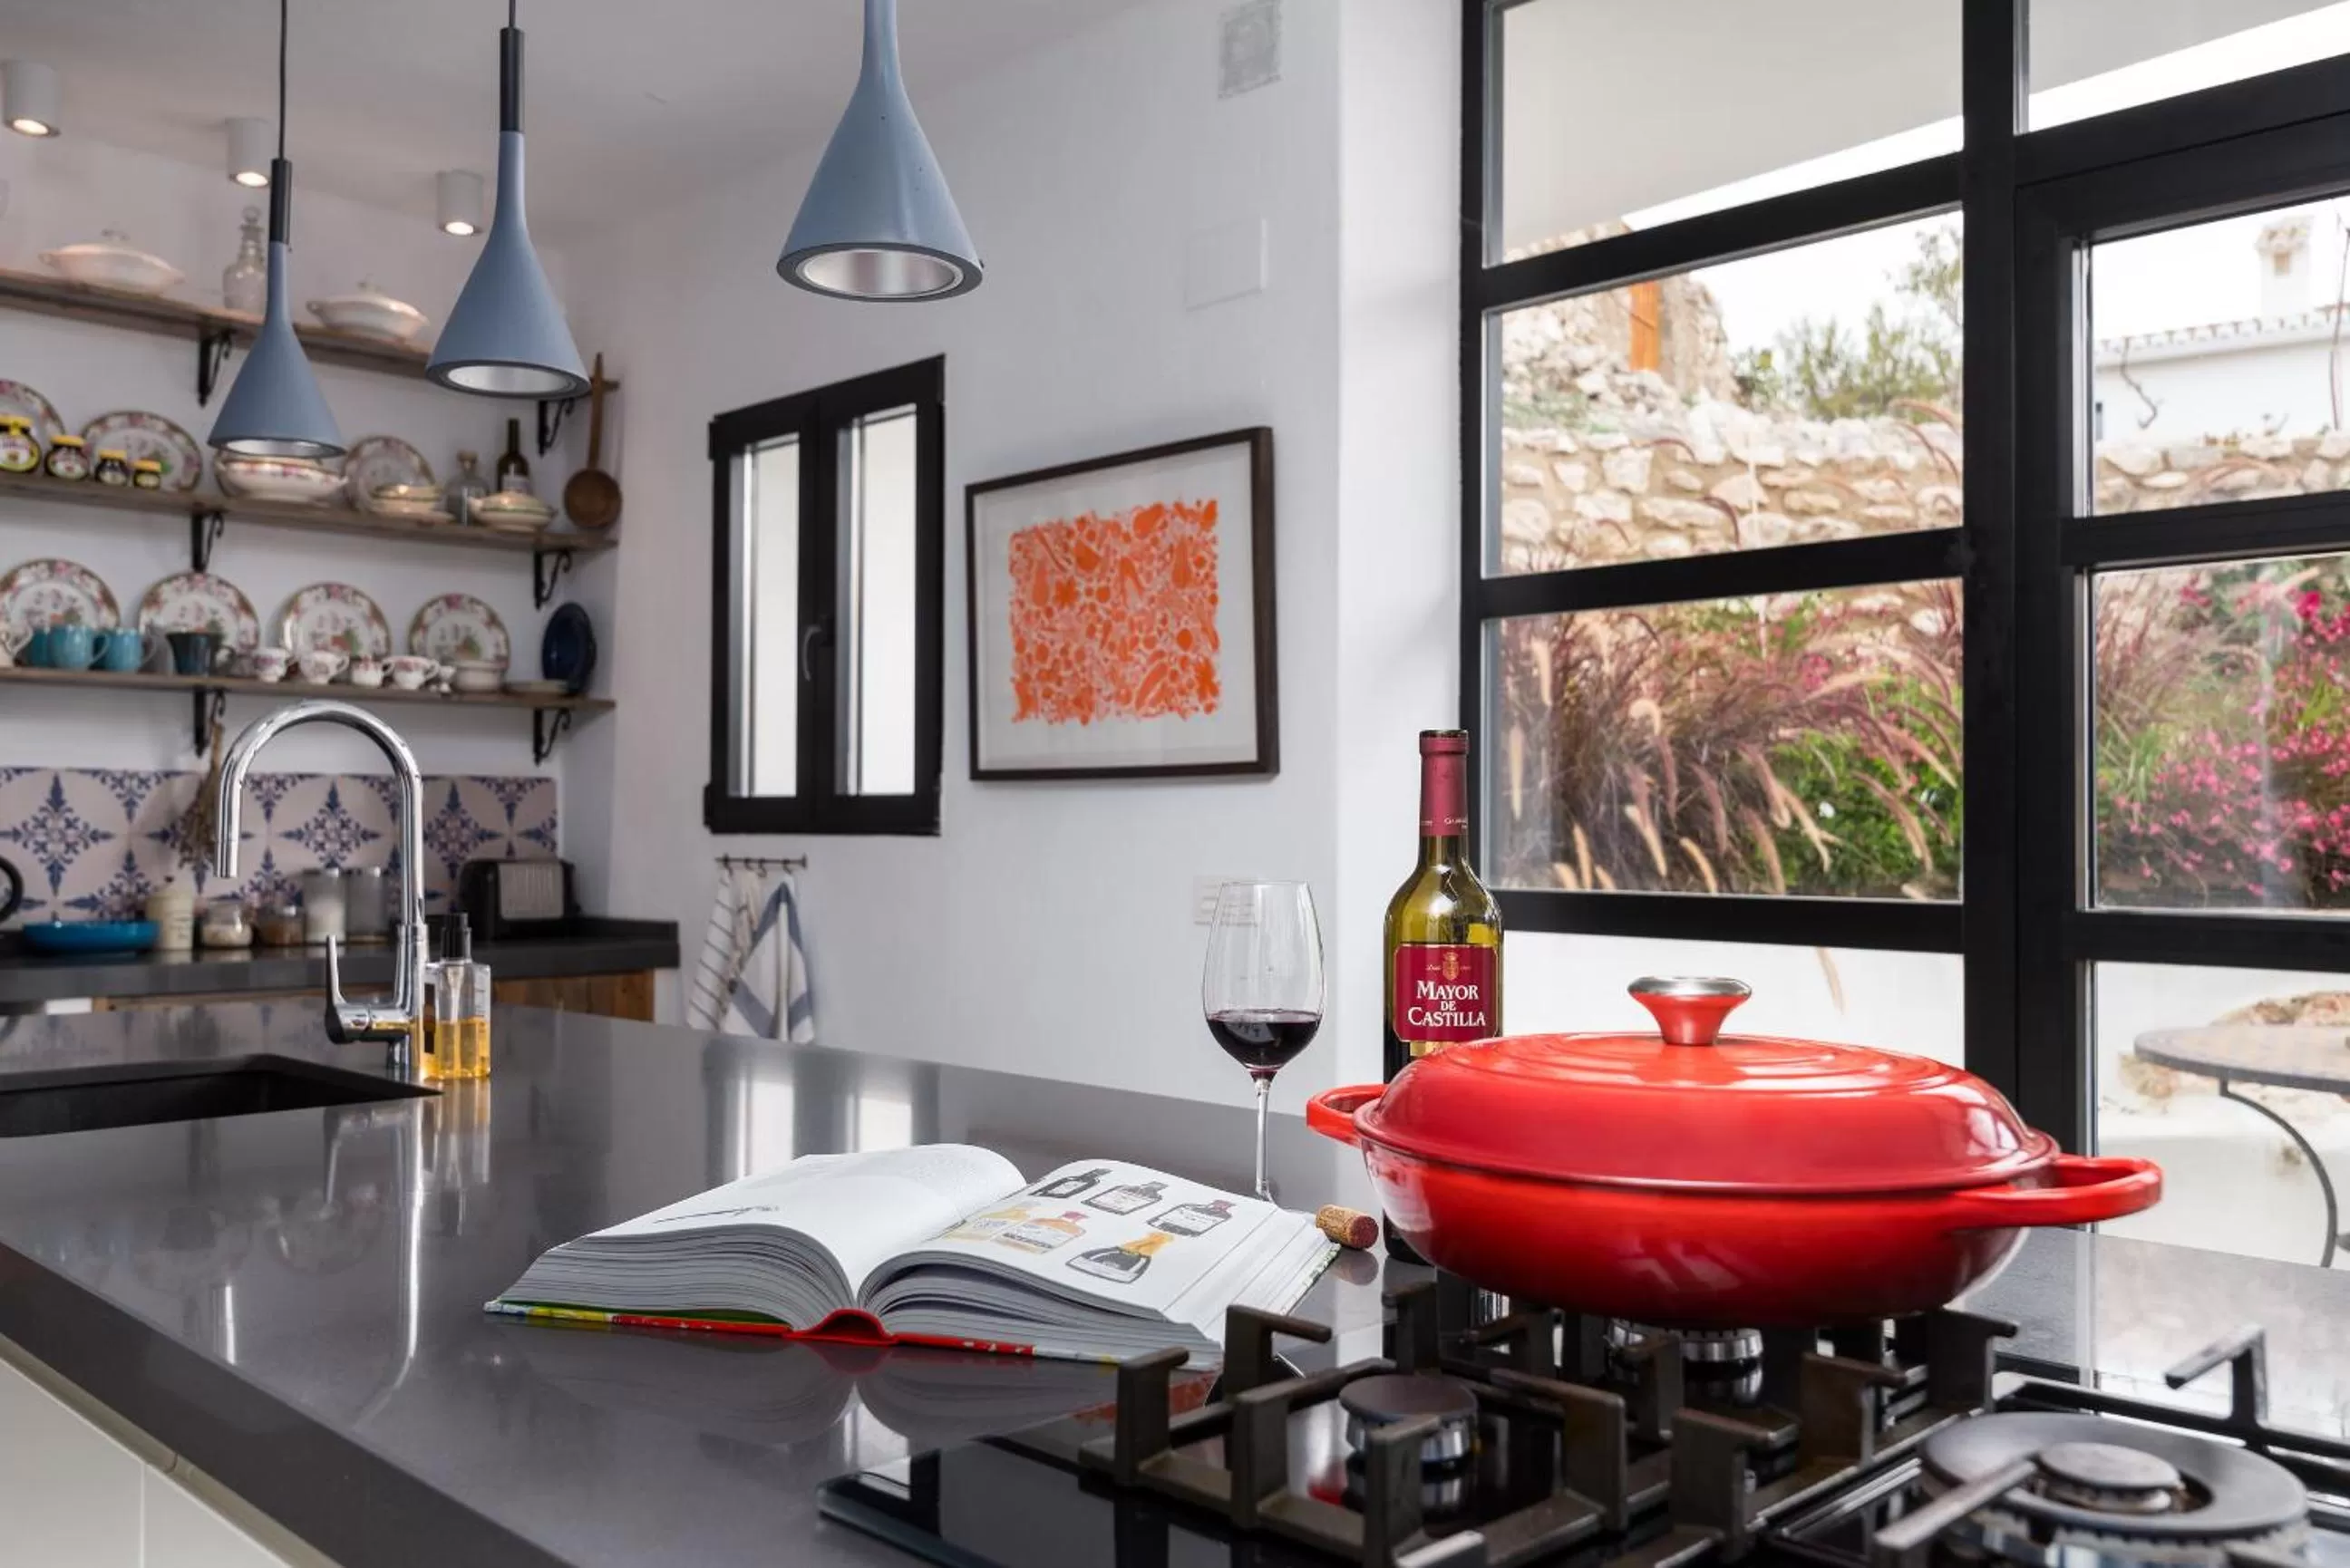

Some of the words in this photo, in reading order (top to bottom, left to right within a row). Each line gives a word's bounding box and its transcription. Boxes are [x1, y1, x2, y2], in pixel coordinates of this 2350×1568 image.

[1416, 980, 1479, 1001] MAYOR
[1440, 1001, 1456, 1011] DE
[1407, 1007, 1486, 1027] CASTILLA
